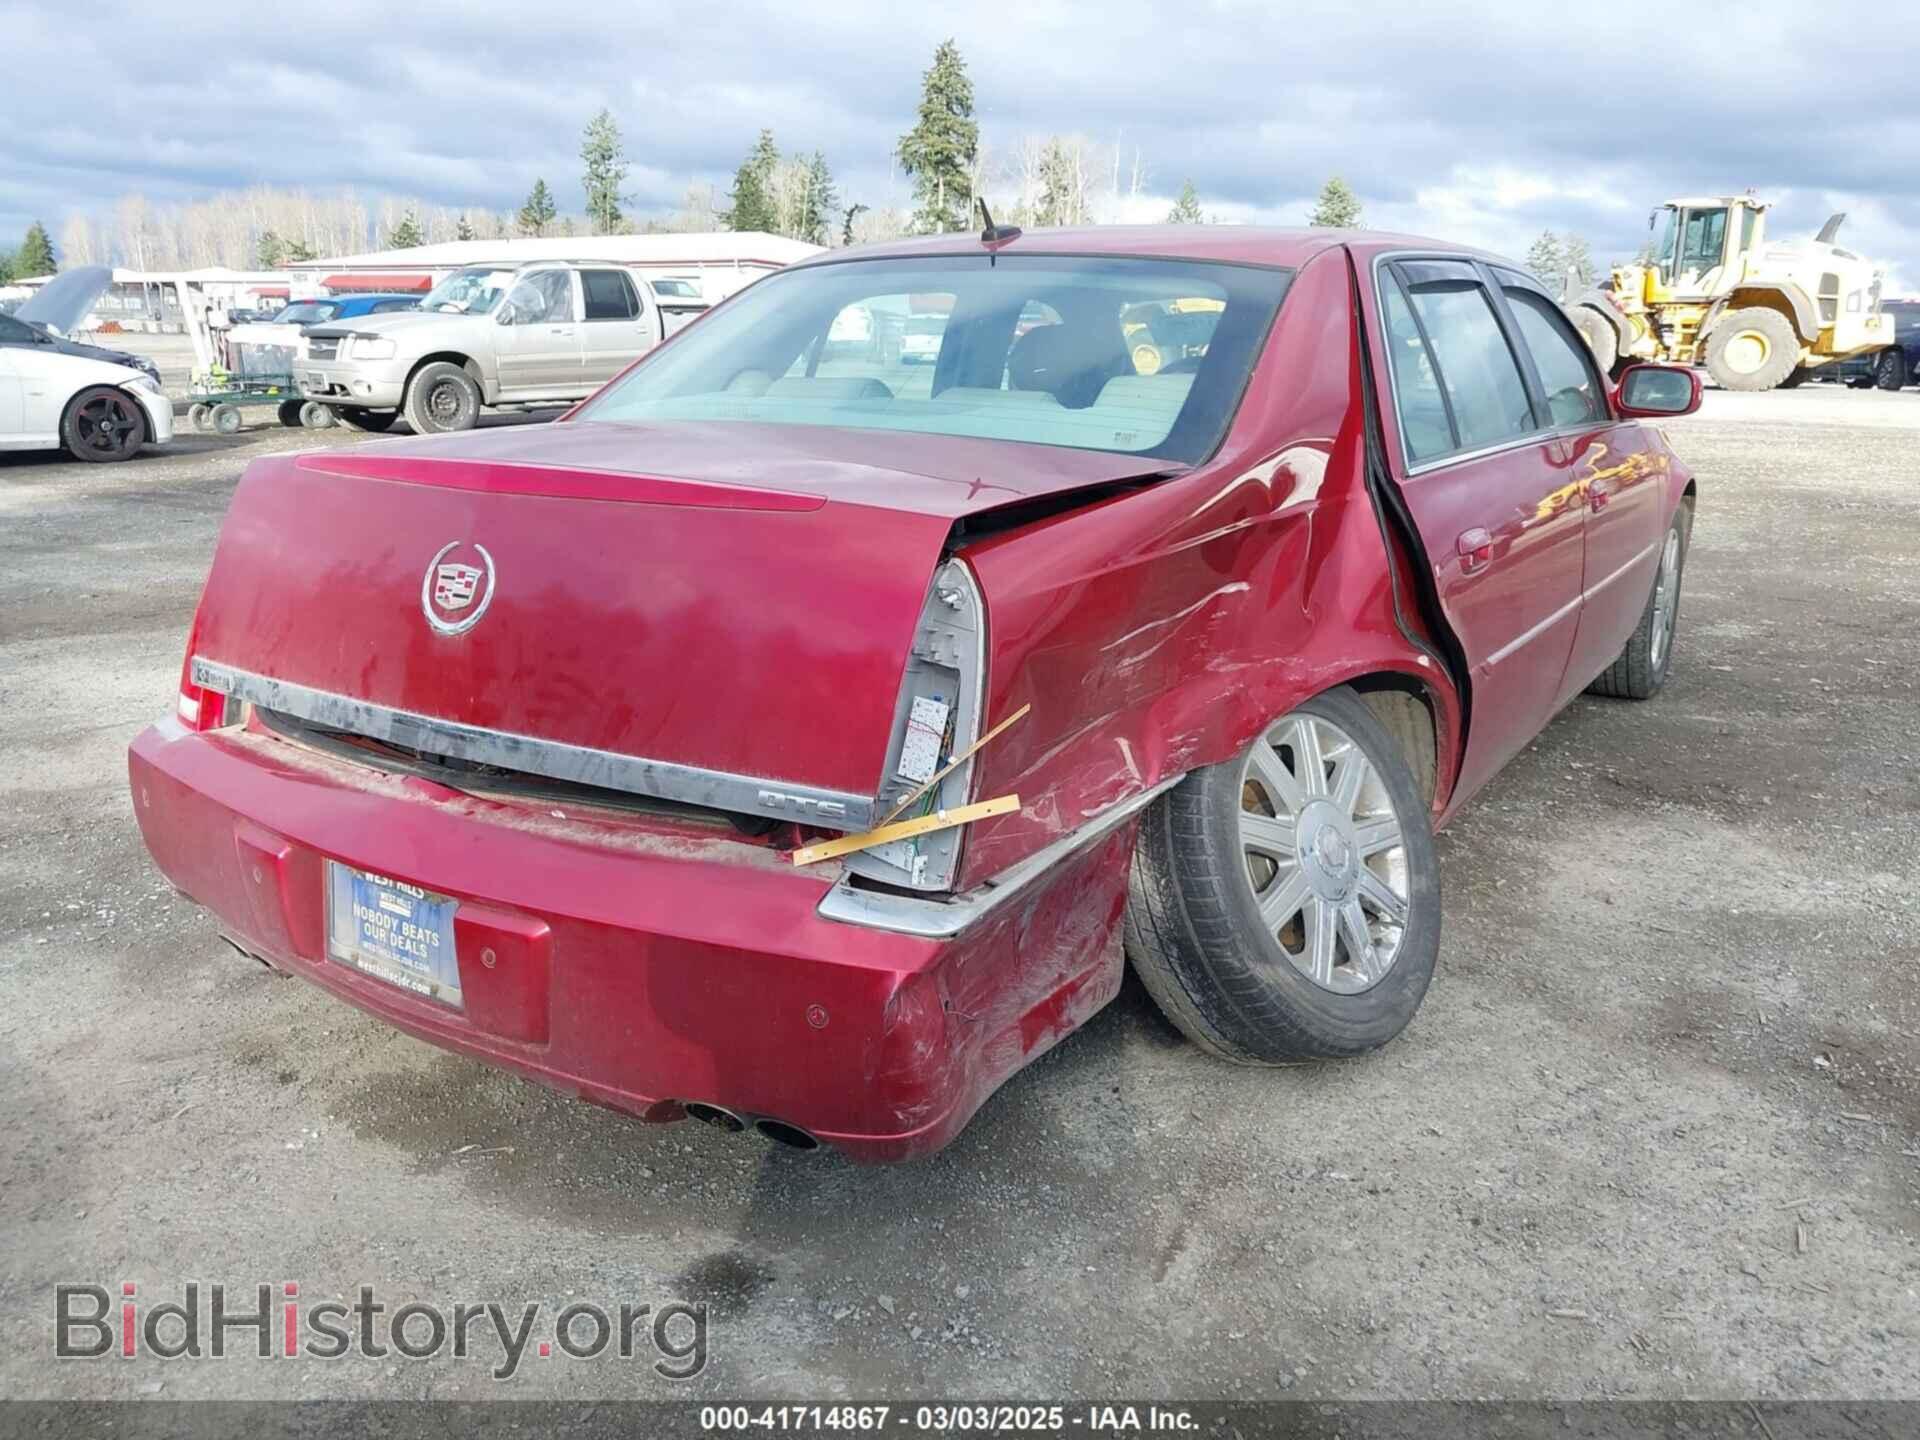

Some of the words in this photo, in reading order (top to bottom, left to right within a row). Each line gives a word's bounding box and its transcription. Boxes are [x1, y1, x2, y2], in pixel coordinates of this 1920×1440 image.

[758, 790, 846, 818] DTS
[352, 903, 399, 931] NOBODY
[402, 922, 439, 946] BEATS
[364, 922, 387, 943] OUR
[390, 933, 428, 958] DEALS
